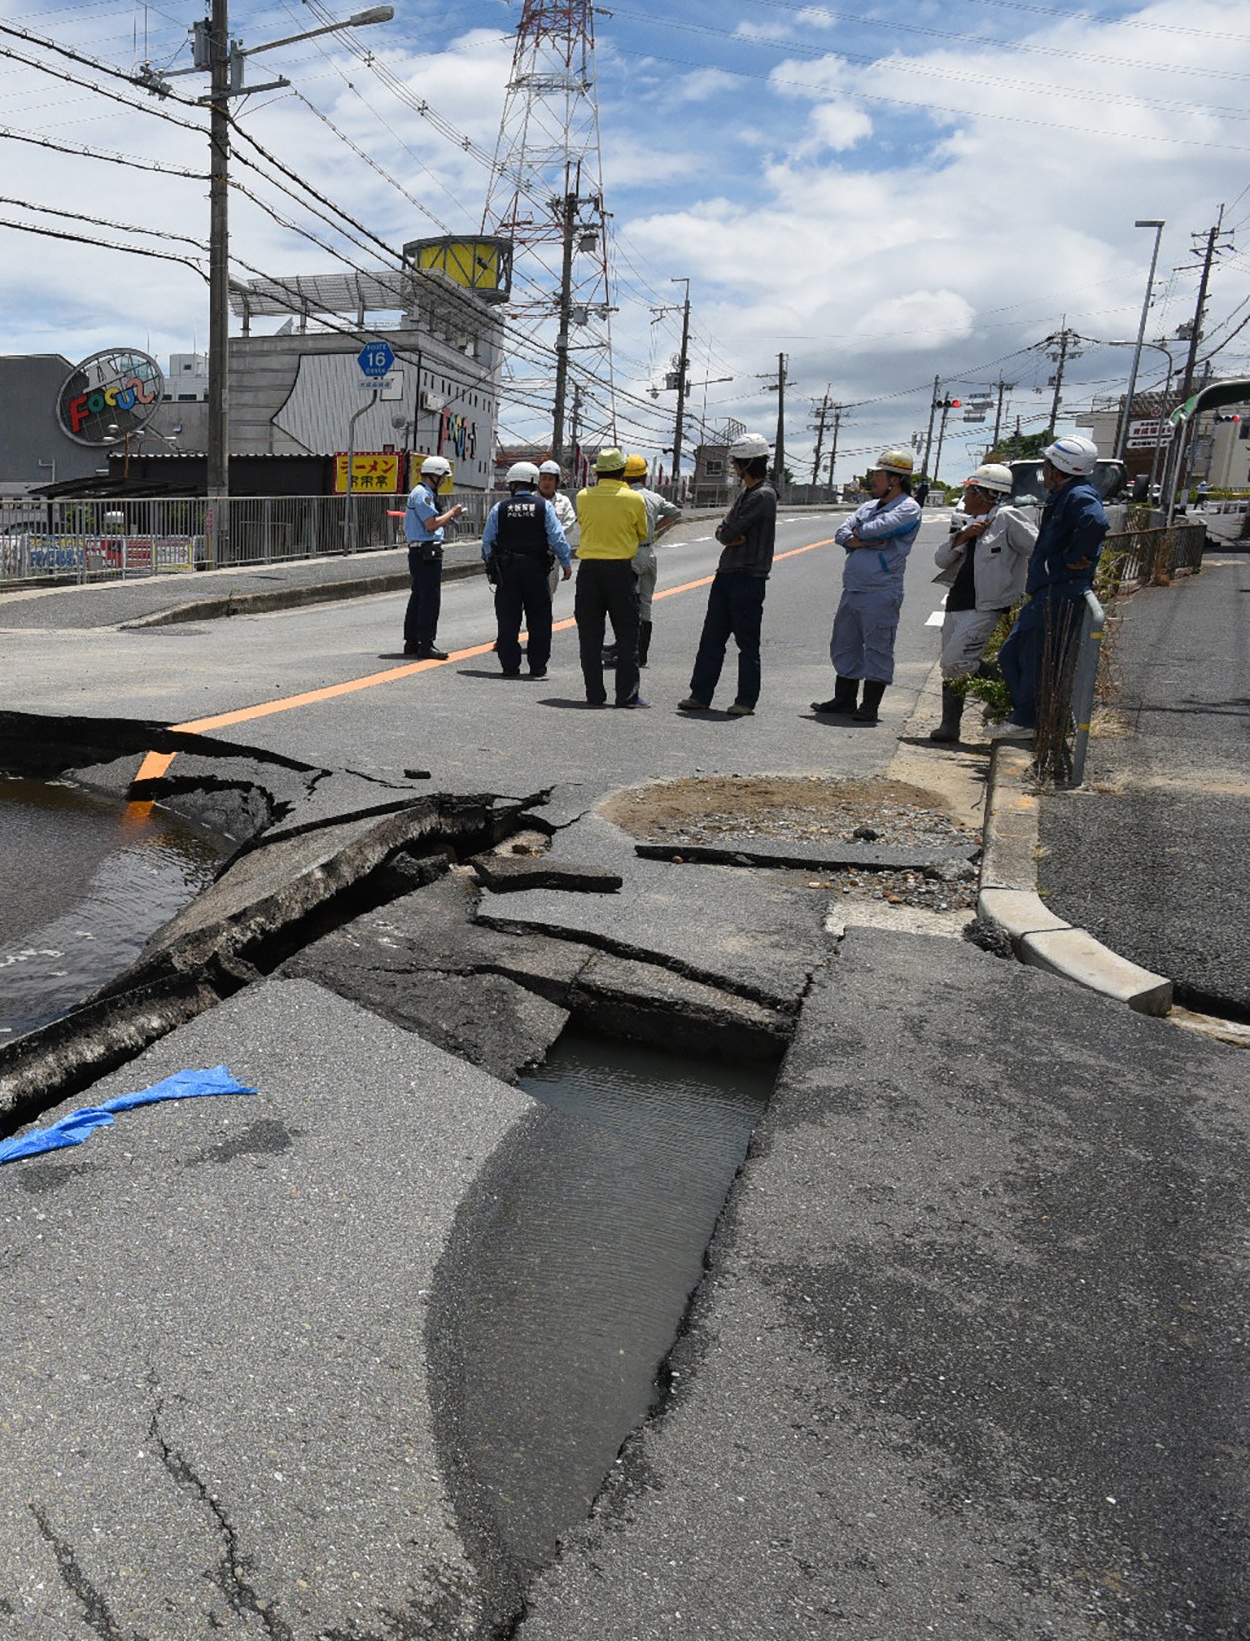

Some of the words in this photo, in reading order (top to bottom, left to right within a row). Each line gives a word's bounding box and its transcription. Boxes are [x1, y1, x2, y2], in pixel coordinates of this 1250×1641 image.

[367, 352, 386, 367] 16
[70, 377, 156, 433] FOCUS
[340, 459, 395, 475] ラーメン
